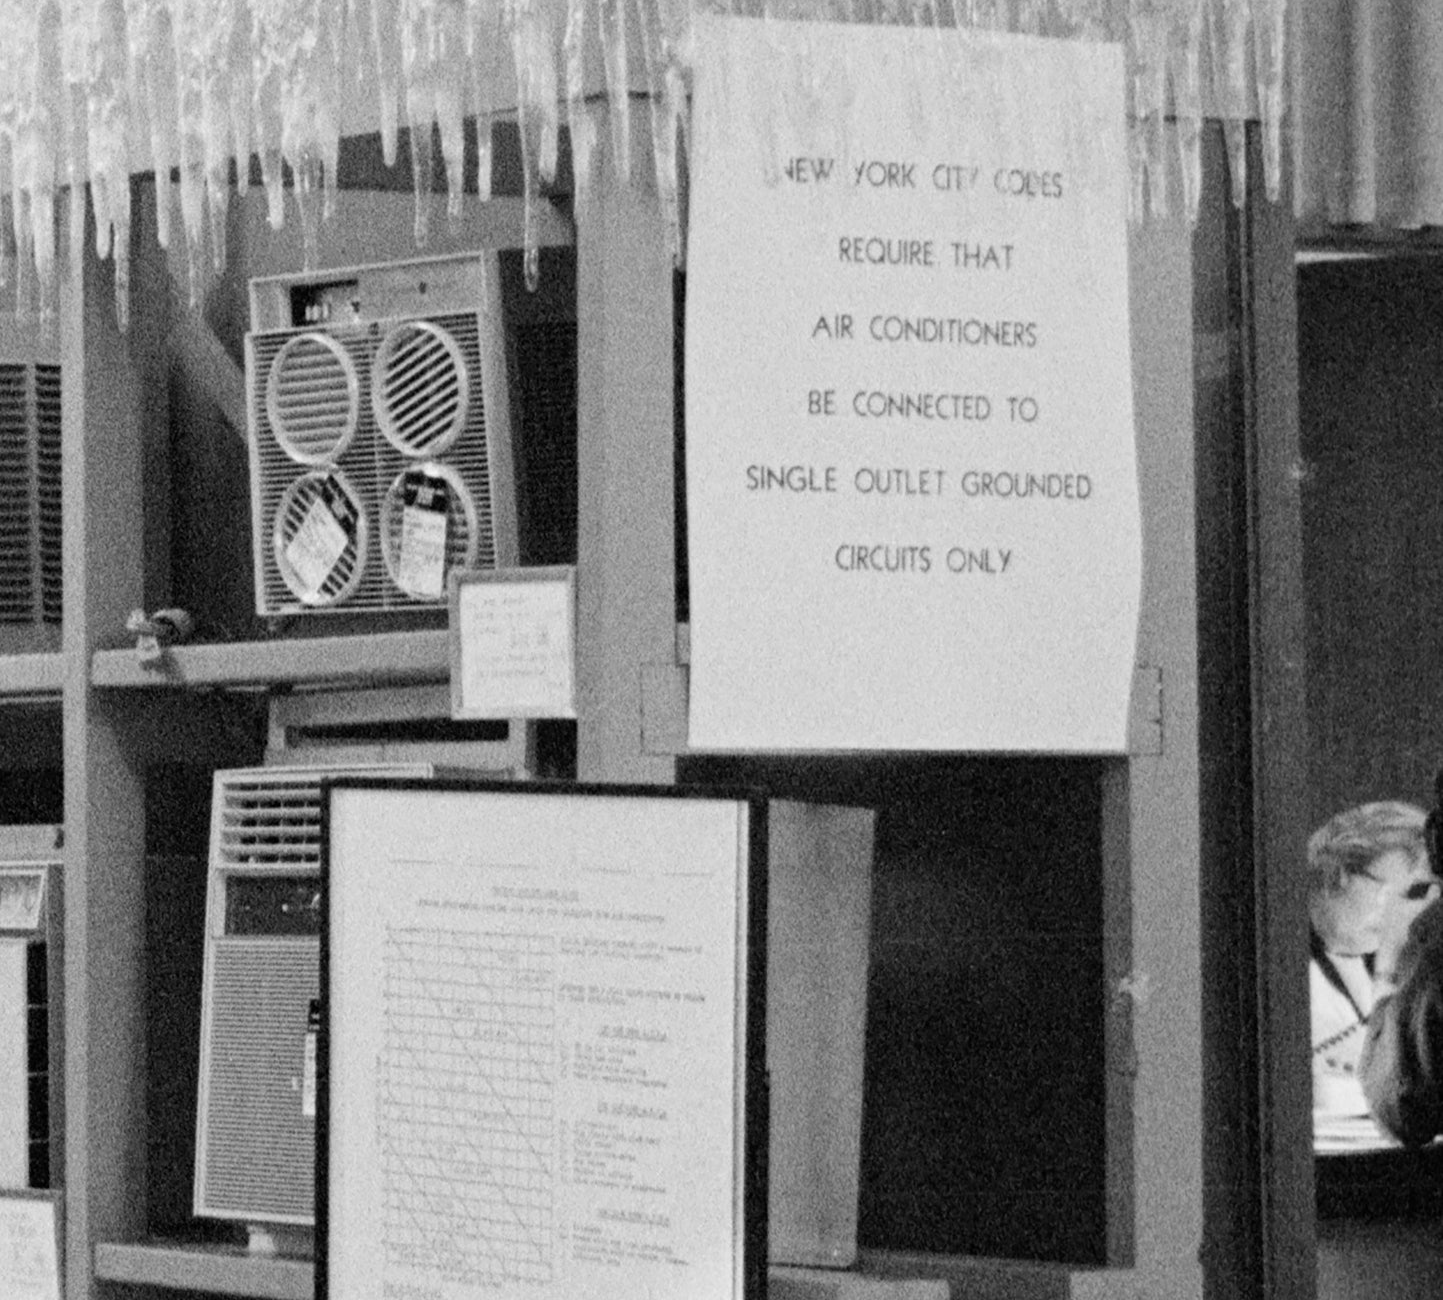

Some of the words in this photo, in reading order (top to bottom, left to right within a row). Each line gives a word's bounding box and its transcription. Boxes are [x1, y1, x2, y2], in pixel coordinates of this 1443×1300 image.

[855, 160, 917, 189] YORK
[838, 236, 935, 268] REQUIRE
[950, 241, 1016, 271] THAT
[811, 313, 855, 340] AIR
[869, 314, 1038, 349] CONDITIONERS
[807, 389, 837, 416] BE
[852, 390, 992, 421] CONNECTED
[1006, 395, 1040, 423] TO
[745, 464, 838, 493] SINGLE
[854, 467, 947, 495] OUTLET
[961, 470, 1093, 500] GROUNDED
[834, 543, 932, 573] CIRCUITS
[946, 546, 1012, 574] ONLY
